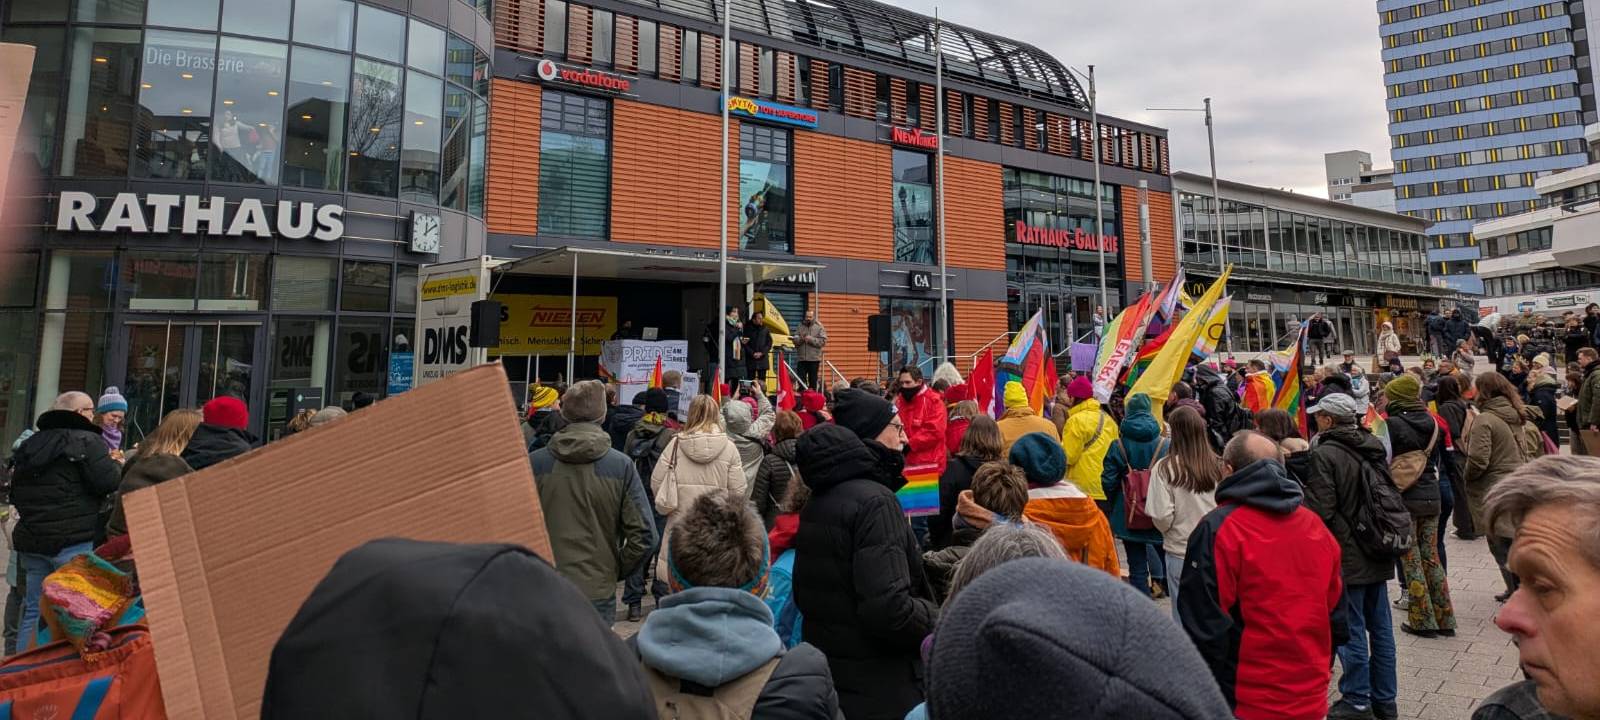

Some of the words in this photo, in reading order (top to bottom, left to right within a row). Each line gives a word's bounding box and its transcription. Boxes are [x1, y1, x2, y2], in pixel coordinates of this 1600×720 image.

[146, 47, 171, 65] Die
[176, 50, 244, 73] Brasserie
[561, 68, 630, 91] vodafone
[56, 191, 345, 241] RATHAUS
[1015, 220, 1119, 253] RATHAUS-GALRIE
[423, 325, 468, 365] DMS
[621, 345, 673, 362] PRIDE
